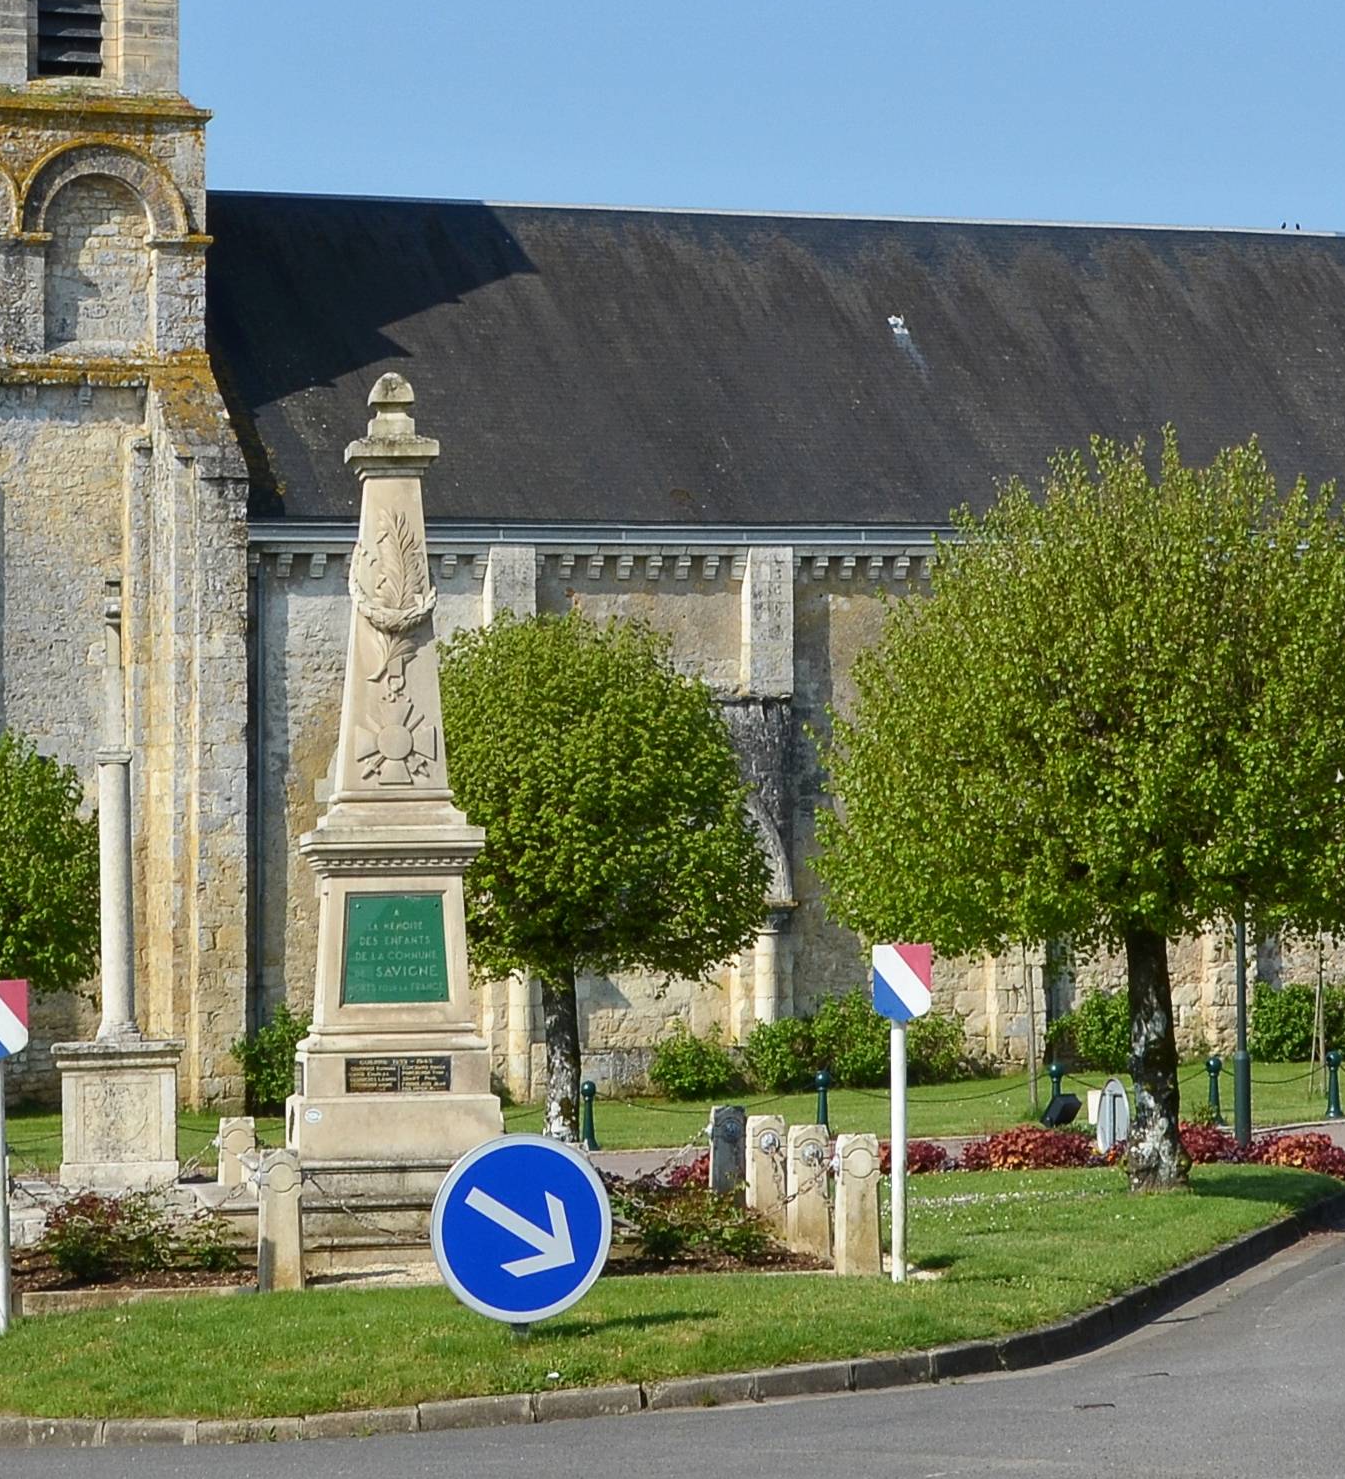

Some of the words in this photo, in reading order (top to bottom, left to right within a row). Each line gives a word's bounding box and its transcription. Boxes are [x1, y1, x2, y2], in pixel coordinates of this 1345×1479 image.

[359, 936, 378, 946] DES
[384, 935, 431, 945] ENFANTS
[355, 951, 367, 961] DE
[371, 952, 384, 961] LA
[388, 950, 438, 960] COMMUNE
[411, 982, 445, 992] FRANCE
